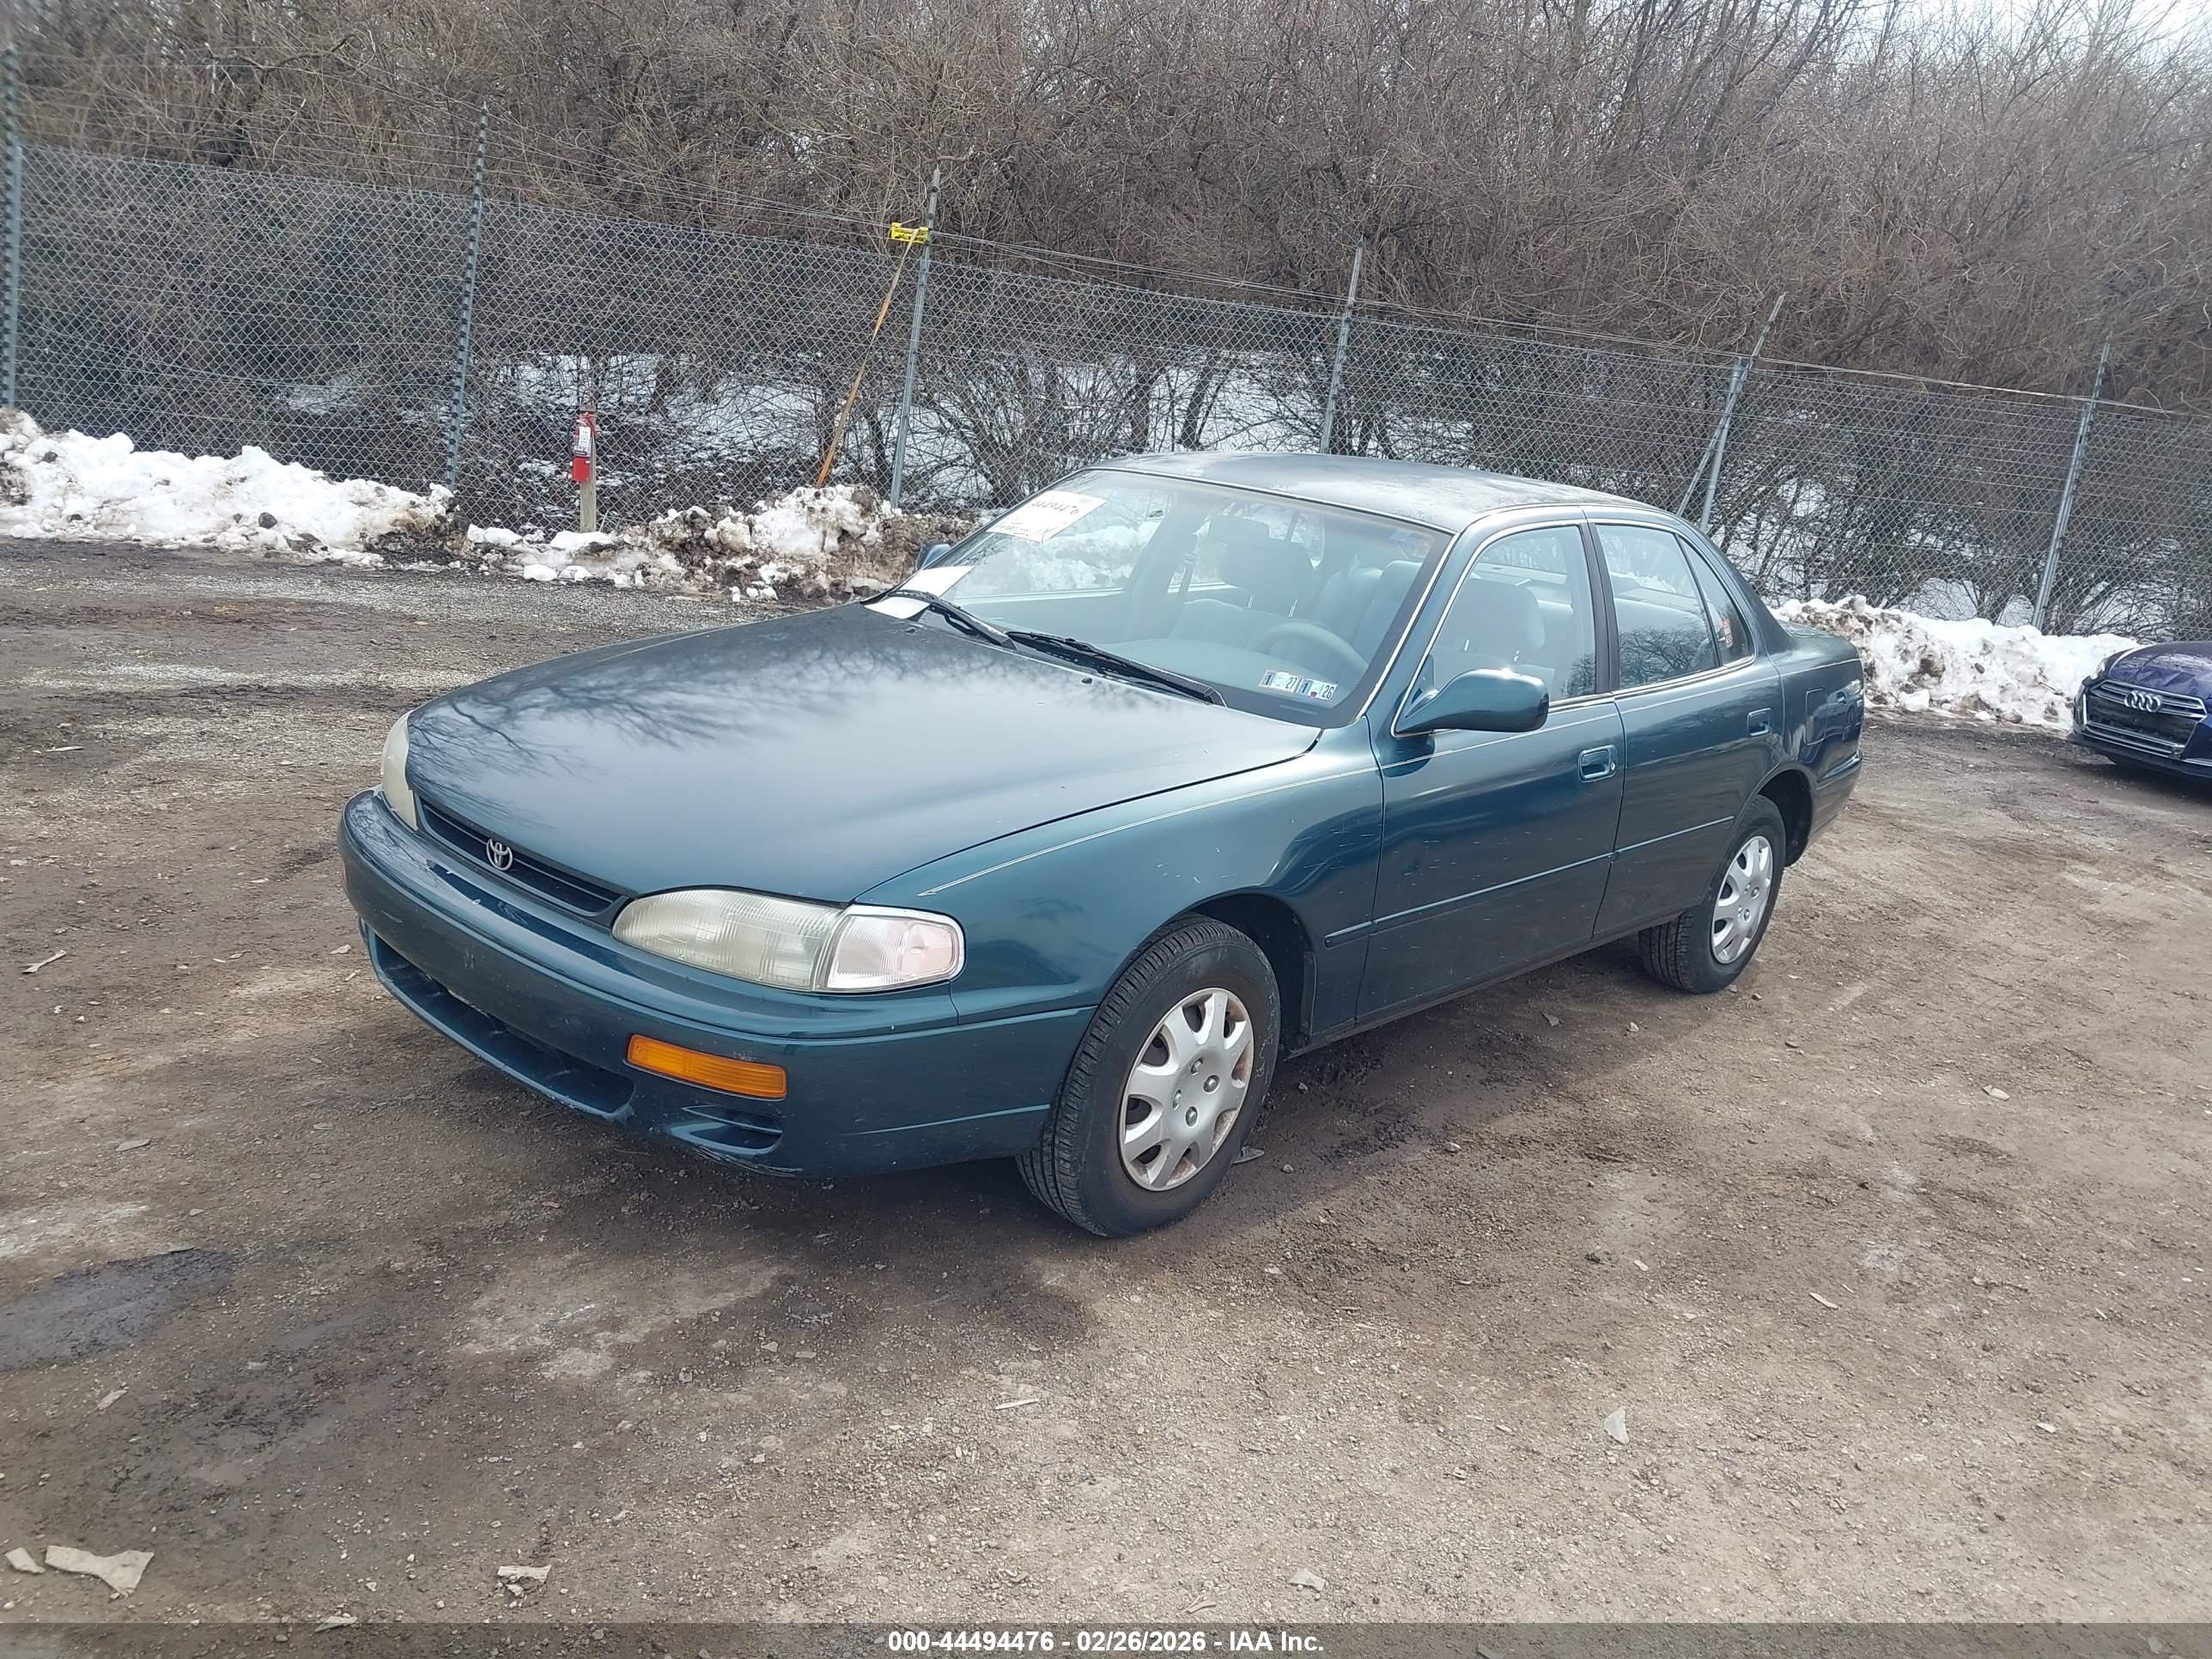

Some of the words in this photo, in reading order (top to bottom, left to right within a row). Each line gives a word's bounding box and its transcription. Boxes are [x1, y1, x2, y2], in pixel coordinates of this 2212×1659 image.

[1265, 674, 1272, 685] 1
[1285, 677, 1297, 690] 27
[1302, 682, 1309, 693] 1
[1322, 684, 1334, 699] 26
